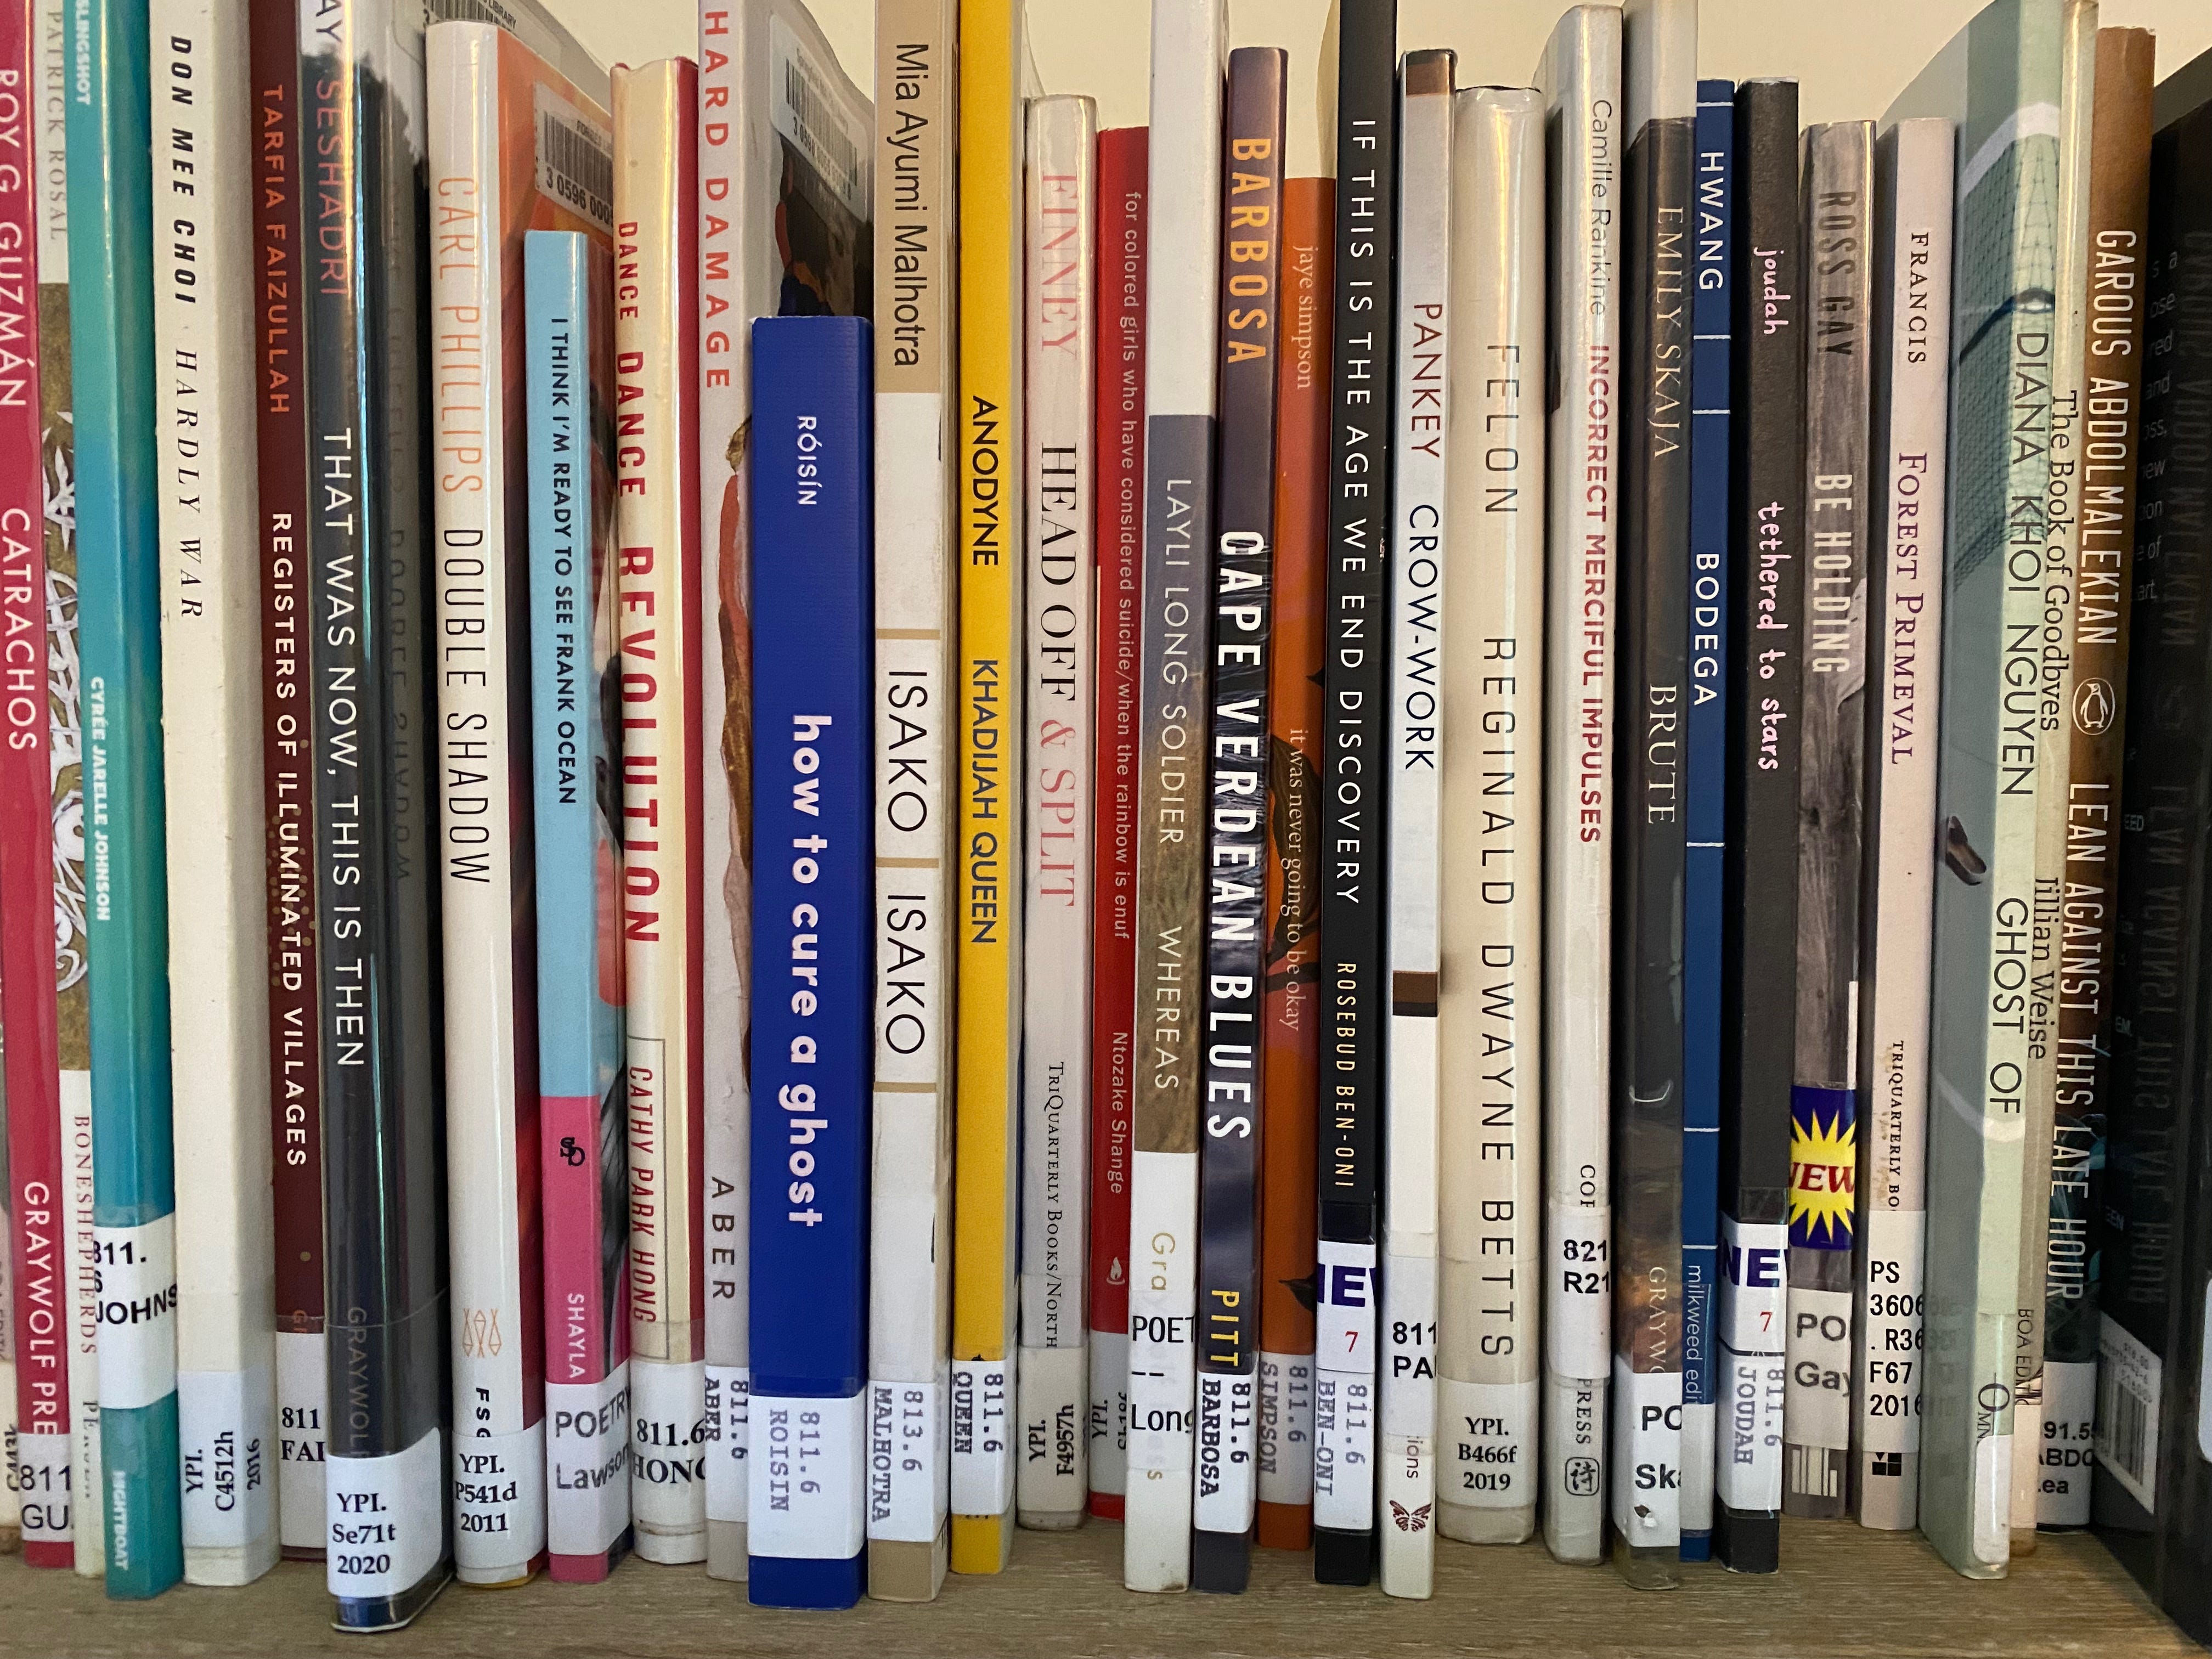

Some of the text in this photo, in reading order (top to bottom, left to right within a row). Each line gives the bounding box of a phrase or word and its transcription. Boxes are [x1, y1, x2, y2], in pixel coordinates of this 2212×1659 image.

[264, 85, 289, 413] TARFIA FAIZULLAH
[317, 80, 348, 295] SESHADRI
[705, 11, 730, 388] HARD DAMAGE
[886, 43, 929, 366] Mia Ayumi Malhotra
[1125, 192, 1142, 221] for
[1228, 138, 1272, 364] BARBOSA
[1590, 99, 1612, 317] Camille Rankine
[1699, 152, 1724, 290] HWANG
[171, 36, 204, 618] DON MEE CHOI HARDLY WAR
[438, 177, 483, 492] CARL PHILLIPS
[619, 222, 638, 319] DANCE
[1042, 176, 1077, 360] FINNEY
[1120, 316, 1139, 362] girls
[1125, 228, 1139, 308] colored
[1291, 246, 1319, 390] jaye simpson
[1647, 206, 1683, 457] EMILY SKAJA
[1754, 247, 1791, 335] joudah
[1908, 232, 1929, 364] FRANCIS
[551, 333, 569, 406] THINK
[553, 417, 570, 452] I'M
[1121, 370, 1136, 412] who
[1121, 419, 1137, 469] have
[1410, 303, 1443, 457] PANKEY
[1485, 345, 1520, 513] FELON
[2077, 230, 2136, 644] GAROUS ABDOLMALEKIAN
[554, 463, 571, 538] READY
[797, 415, 822, 505] RÓISÍN
[972, 396, 998, 566] ANODYNE
[1120, 477, 1135, 591] considered
[1336, 120, 1376, 904] IF THIS IS THE AGE WE END DISCOVERY
[1, 508, 37, 750] CATRACHOS
[555, 547, 572, 576] TO
[555, 585, 573, 624] SEE
[1405, 504, 1440, 770] CROW-WORK
[1580, 346, 1609, 843] INCORRECT MERCIFUL IMPULSES
[1694, 554, 1720, 707] BODEGA
[1757, 501, 1792, 770] tethered to stars
[1812, 474, 1852, 673] BE HOLDING
[2001, 332, 2048, 795] DIANA KHOI NGUYEN
[444, 530, 490, 882] DOUBLE SHADOW
[556, 634, 575, 712] FRANK
[617, 352, 659, 941] DANCE REVOLUTION
[1040, 443, 1077, 906] HEAD OFF & SPLIT
[1160, 479, 1191, 844] LAYLI LONG SOLDIER
[324, 428, 364, 1065] THAT WAS NOW, THIS IS THEN
[558, 721, 576, 803] OCEAN
[887, 671, 928, 832] ISAKO
[969, 660, 998, 943] KHADIJAH QUEEN
[1117, 743, 1131, 776] the
[1647, 684, 1677, 824] BRUTE
[94, 830, 111, 921] JOHNSON
[273, 513, 306, 1165] REGISTERS OF ILLUMINATED VILLAGES
[1115, 786, 1130, 870] rainbow
[1115, 871, 1131, 887] is
[1207, 532, 1265, 1138] CAPE VERDEAN BLUES
[1279, 728, 1309, 1031] it was never going to be okay
[778, 715, 832, 1227] how to cure a ghost
[885, 895, 926, 1055] ISAKO
[1115, 895, 1128, 939] enuf
[1155, 926, 1182, 1089] WHEREAS
[1481, 637, 1516, 1355] REGINALD DWAYNE BETTS
[1990, 898, 2028, 1113] GHOST OF
[2047, 783, 2109, 1300] LEAN AGAINST THIS LATE HOUR
[1108, 1032, 1128, 1194] Ntozake Shange
[1335, 963, 1357, 1187] ROSEBUD BEN-ONI
[629, 1068, 656, 1323] CATHY PARK HONG
[712, 1177, 735, 1299] ABER
[24, 1182, 55, 1370] GRAYWOLF
[567, 1293, 584, 1378] SHAYLA
[1210, 1290, 1240, 1366] PITT
[1684, 1265, 1702, 1370] milkweed
[770, 1410, 789, 1511] ROISIN
[799, 1412, 821, 1494] 811.6
[871, 1387, 893, 1522] MALHOTRA
[901, 1391, 923, 1472] 813.6
[952, 1373, 972, 1454] QUEEN
[983, 1373, 1004, 1454] 811.6
[1200, 1379, 1221, 1497] BARBOSA
[1230, 1382, 1251, 1464] 811.6
[1463, 1473, 1511, 1490] 2019
[332, 1523, 396, 1544] Se71t
[337, 1555, 390, 1574] 2020
